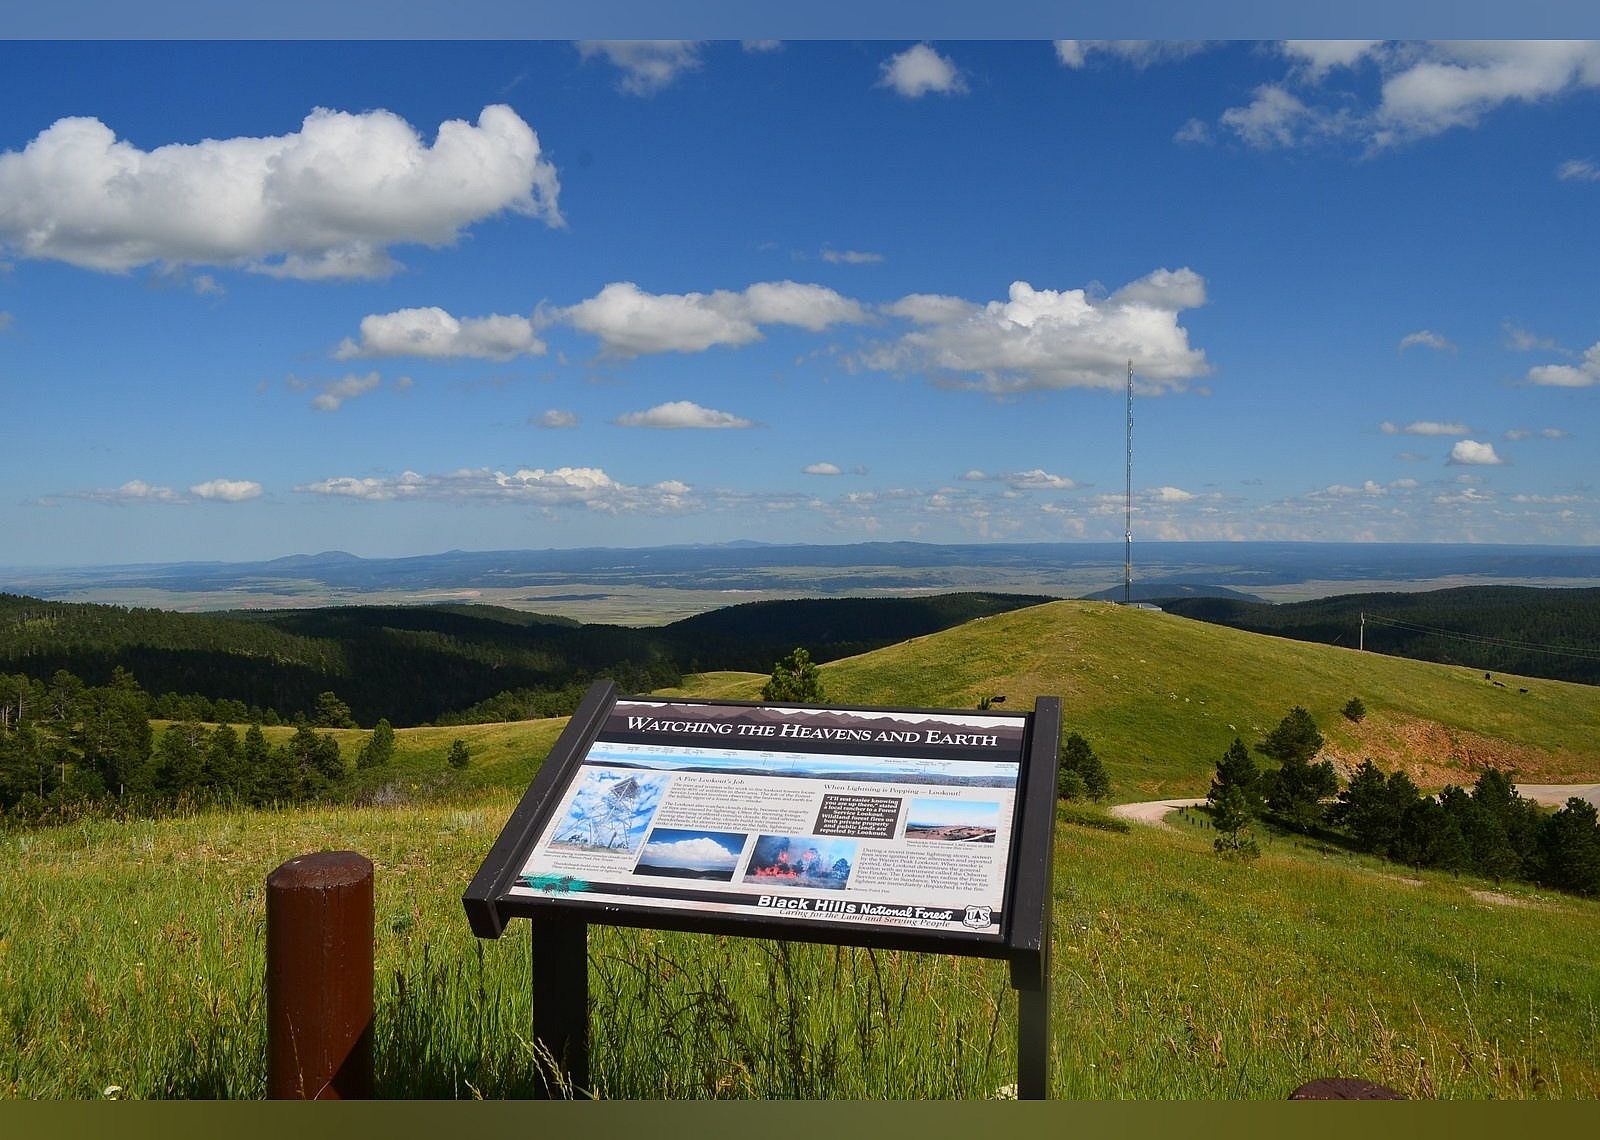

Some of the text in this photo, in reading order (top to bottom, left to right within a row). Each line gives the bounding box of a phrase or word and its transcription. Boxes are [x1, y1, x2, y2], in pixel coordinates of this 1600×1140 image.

[625, 717, 999, 747] WATCHING THE HEAVENS AND EARTH
[759, 896, 953, 921] Black Hills National Forest
[780, 908, 809, 918] Caring
[810, 910, 824, 918] for
[866, 914, 882, 922] and
[883, 916, 917, 926] Serving
[920, 918, 951, 928] People
